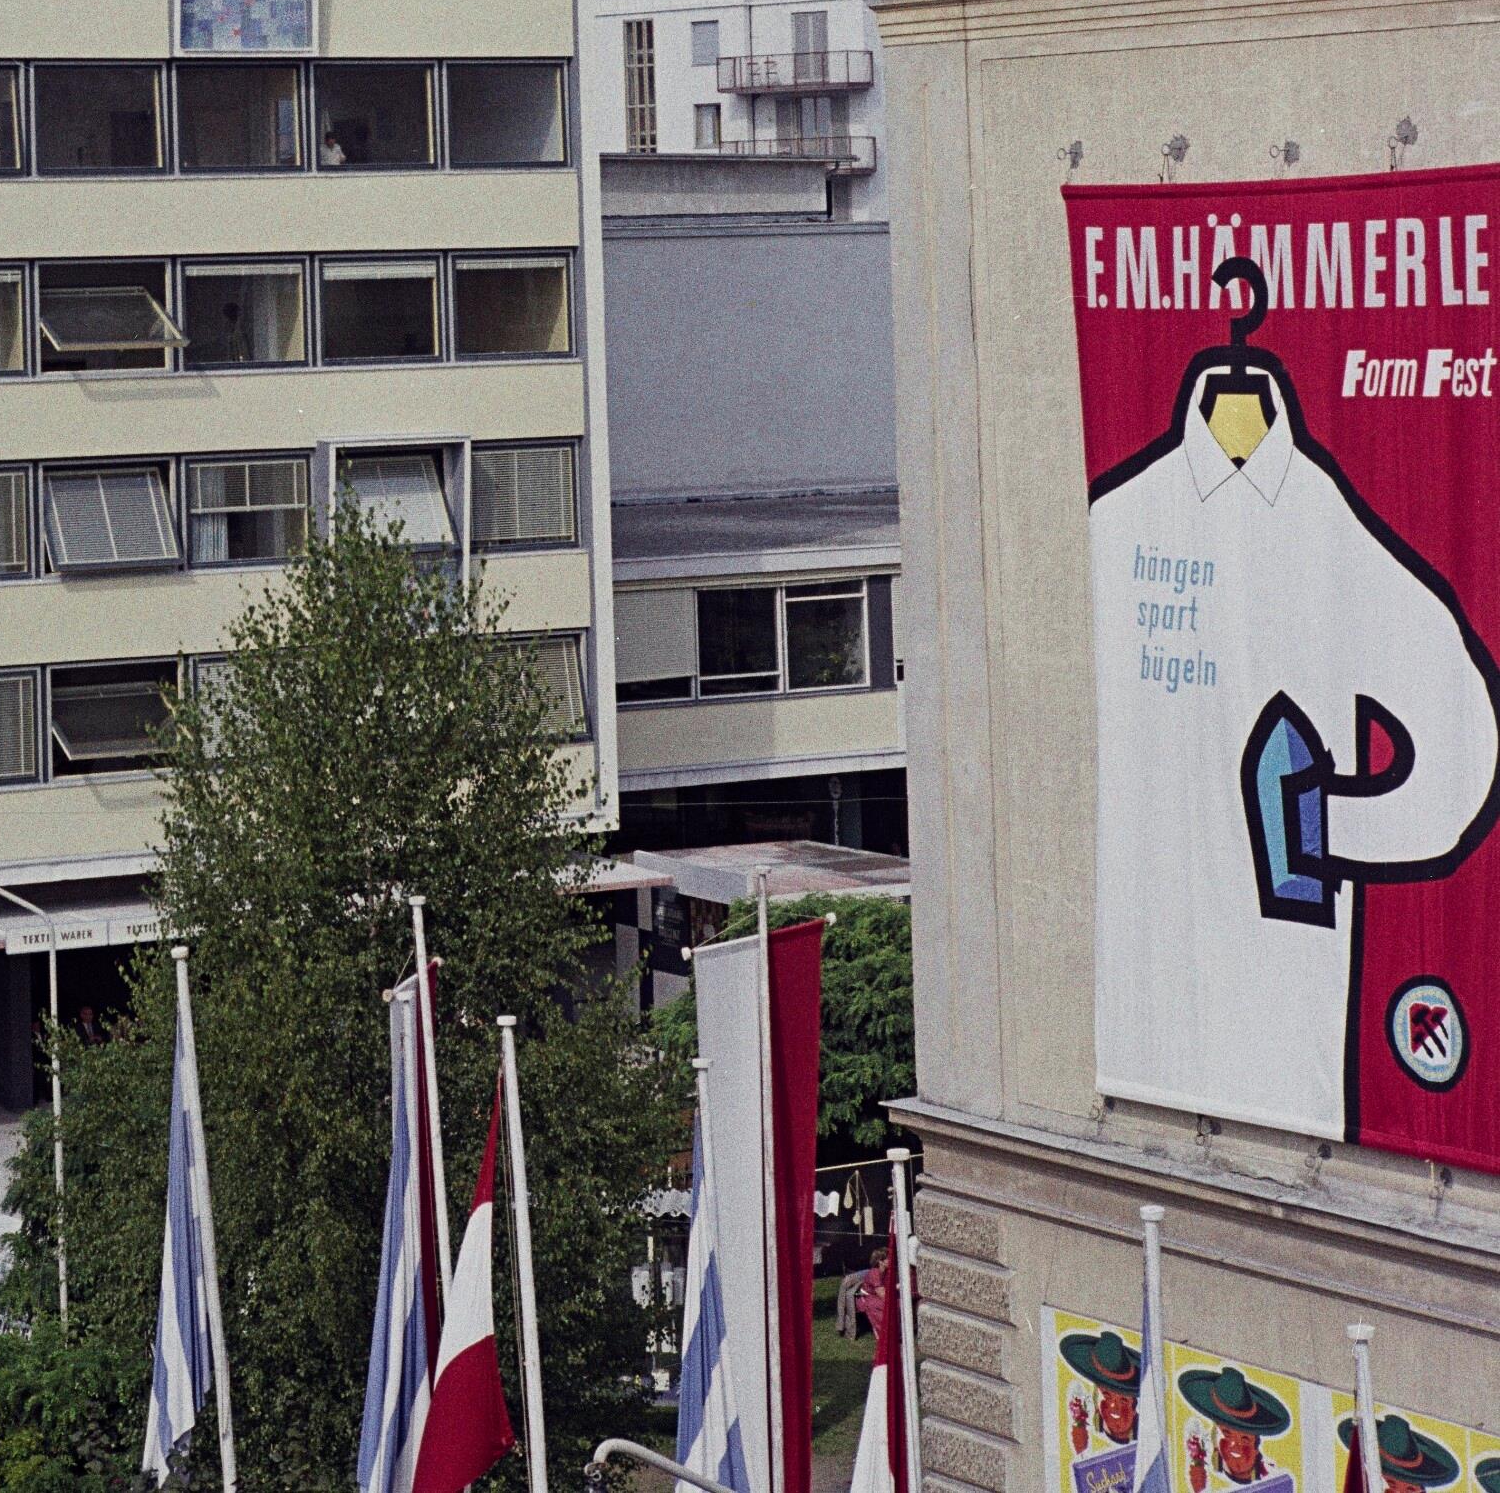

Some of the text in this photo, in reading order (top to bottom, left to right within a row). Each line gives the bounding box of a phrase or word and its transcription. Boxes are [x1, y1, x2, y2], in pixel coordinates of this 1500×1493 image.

[1342, 347, 1497, 397] Form Fest
[1134, 544, 1216, 594] hängen
[1137, 596, 1198, 638] spart
[1140, 644, 1217, 693] bügeln
[60, 929, 93, 942] WAREN
